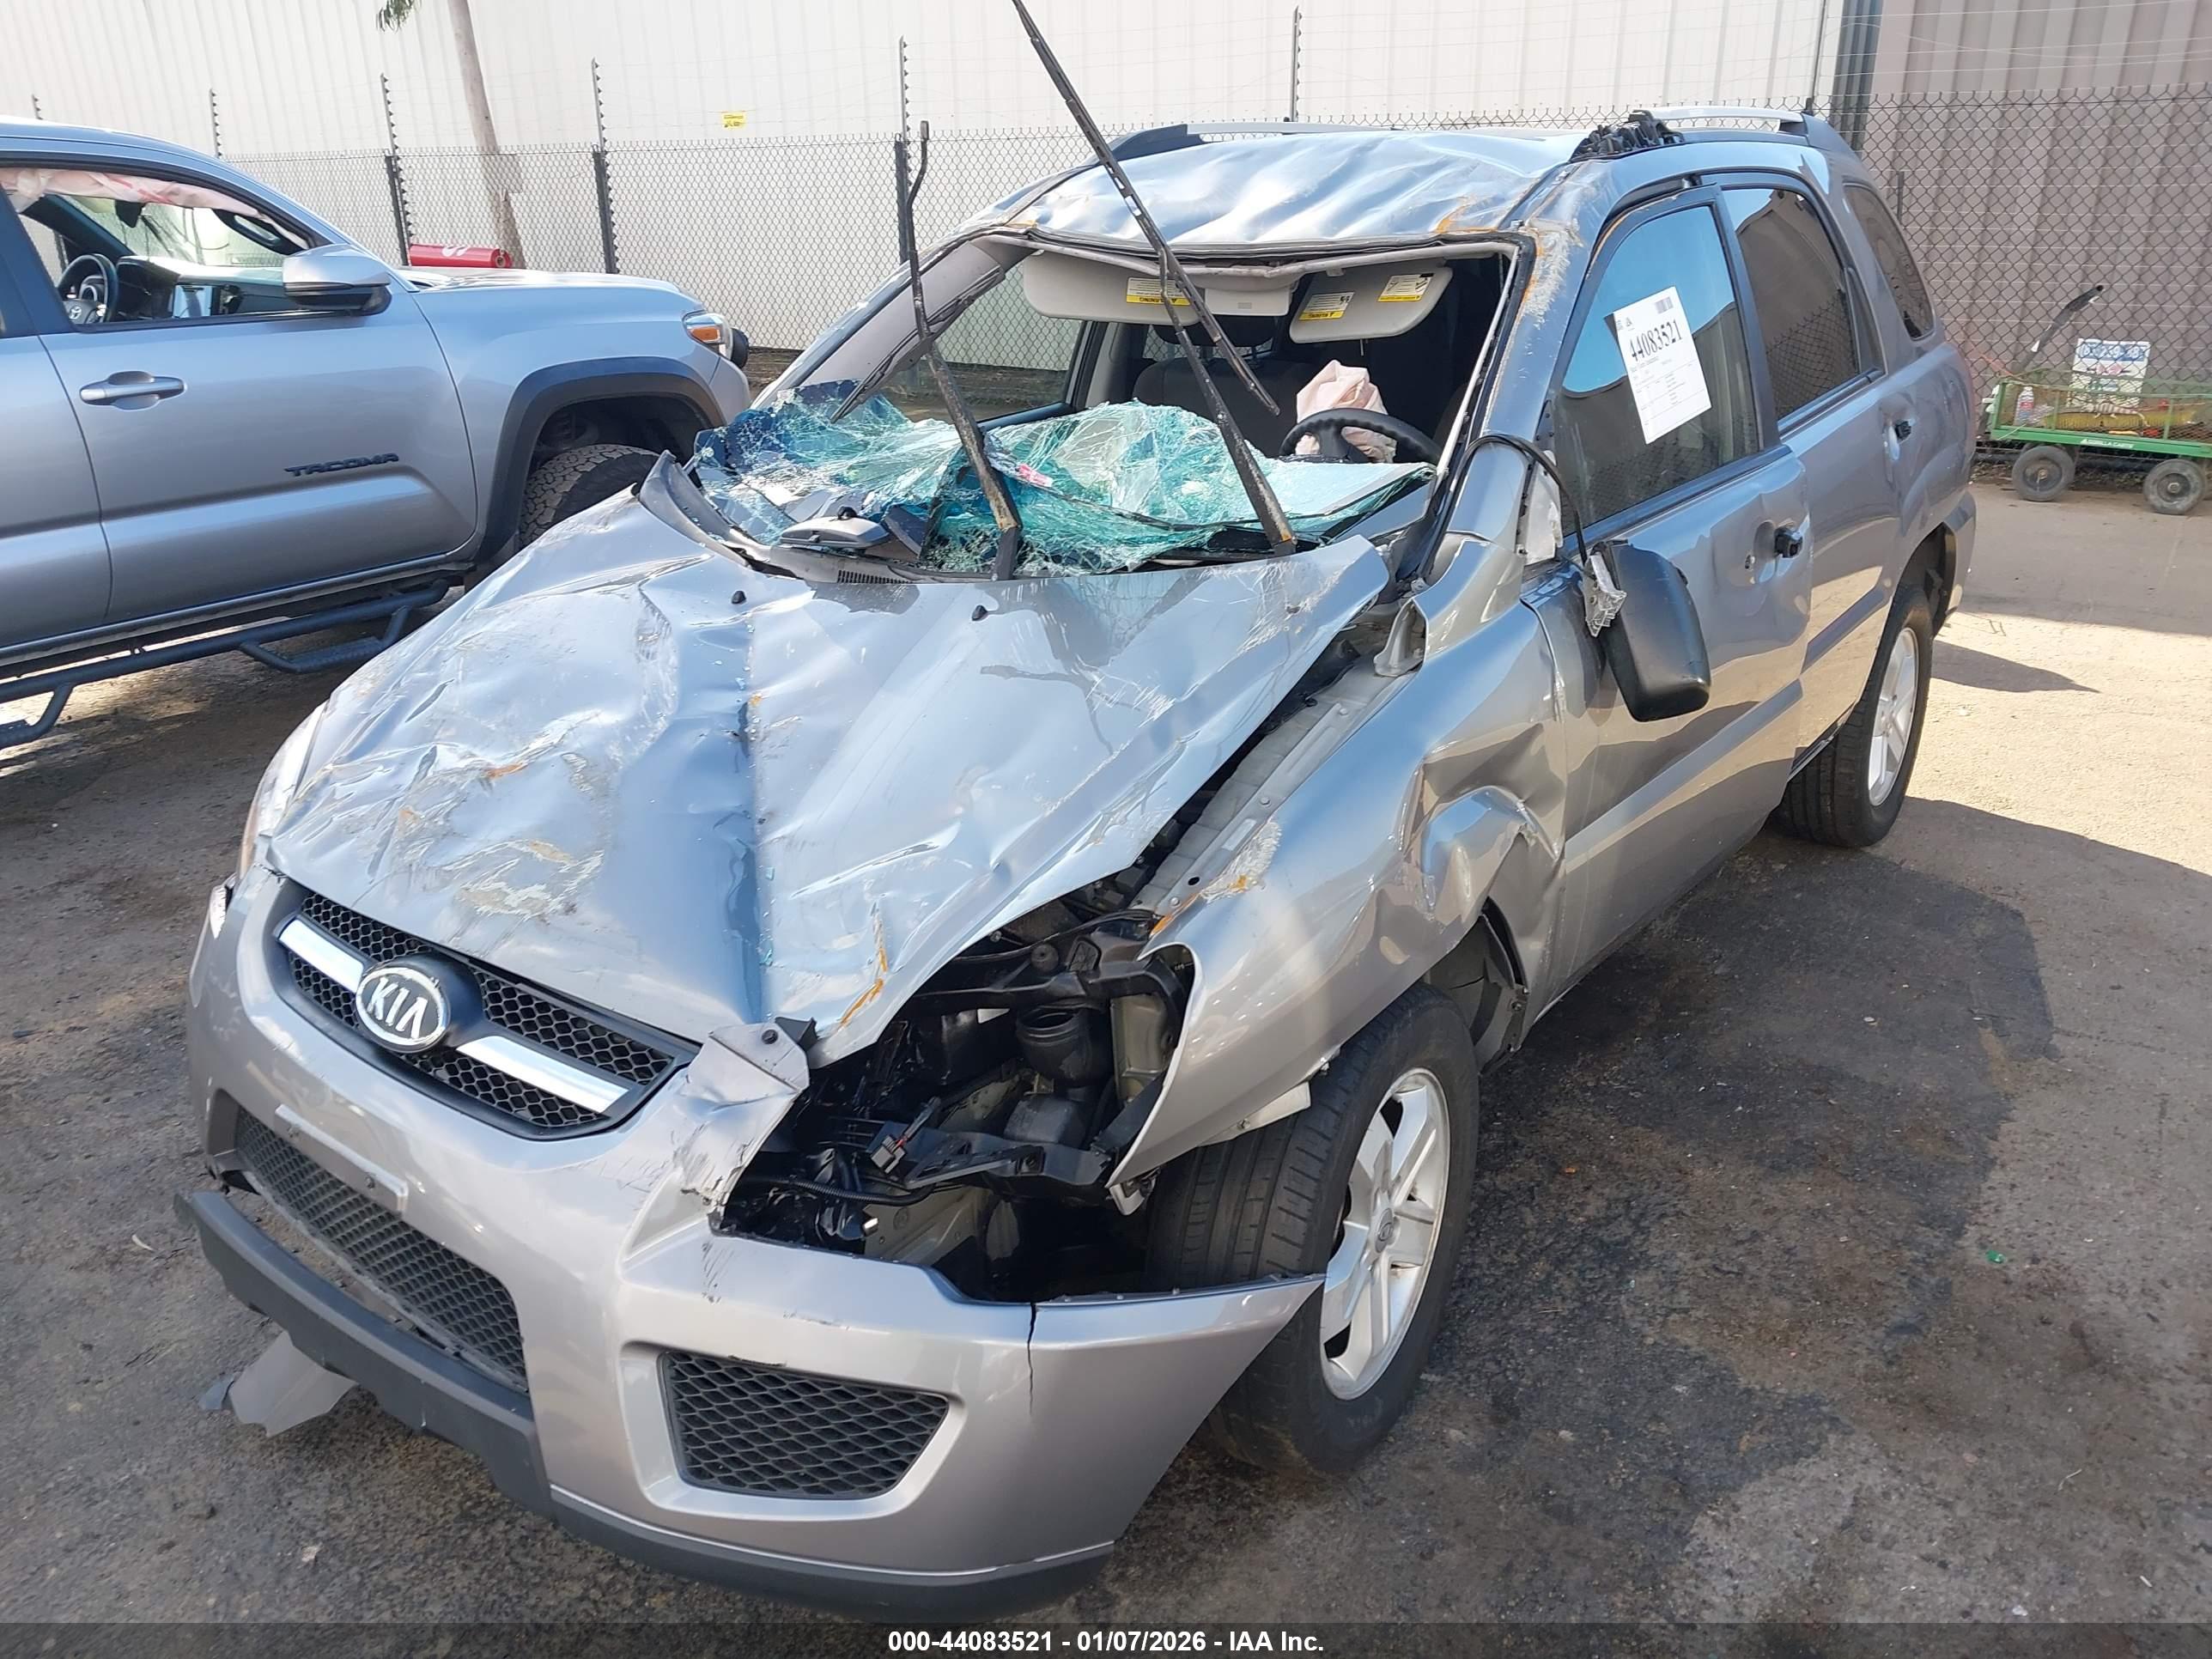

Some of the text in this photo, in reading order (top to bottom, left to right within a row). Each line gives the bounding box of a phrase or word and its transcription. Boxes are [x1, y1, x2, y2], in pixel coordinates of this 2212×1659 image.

[1629, 319, 1683, 362] 44083521
[284, 453, 399, 477] TACOMA
[367, 976, 428, 1039] KIA
